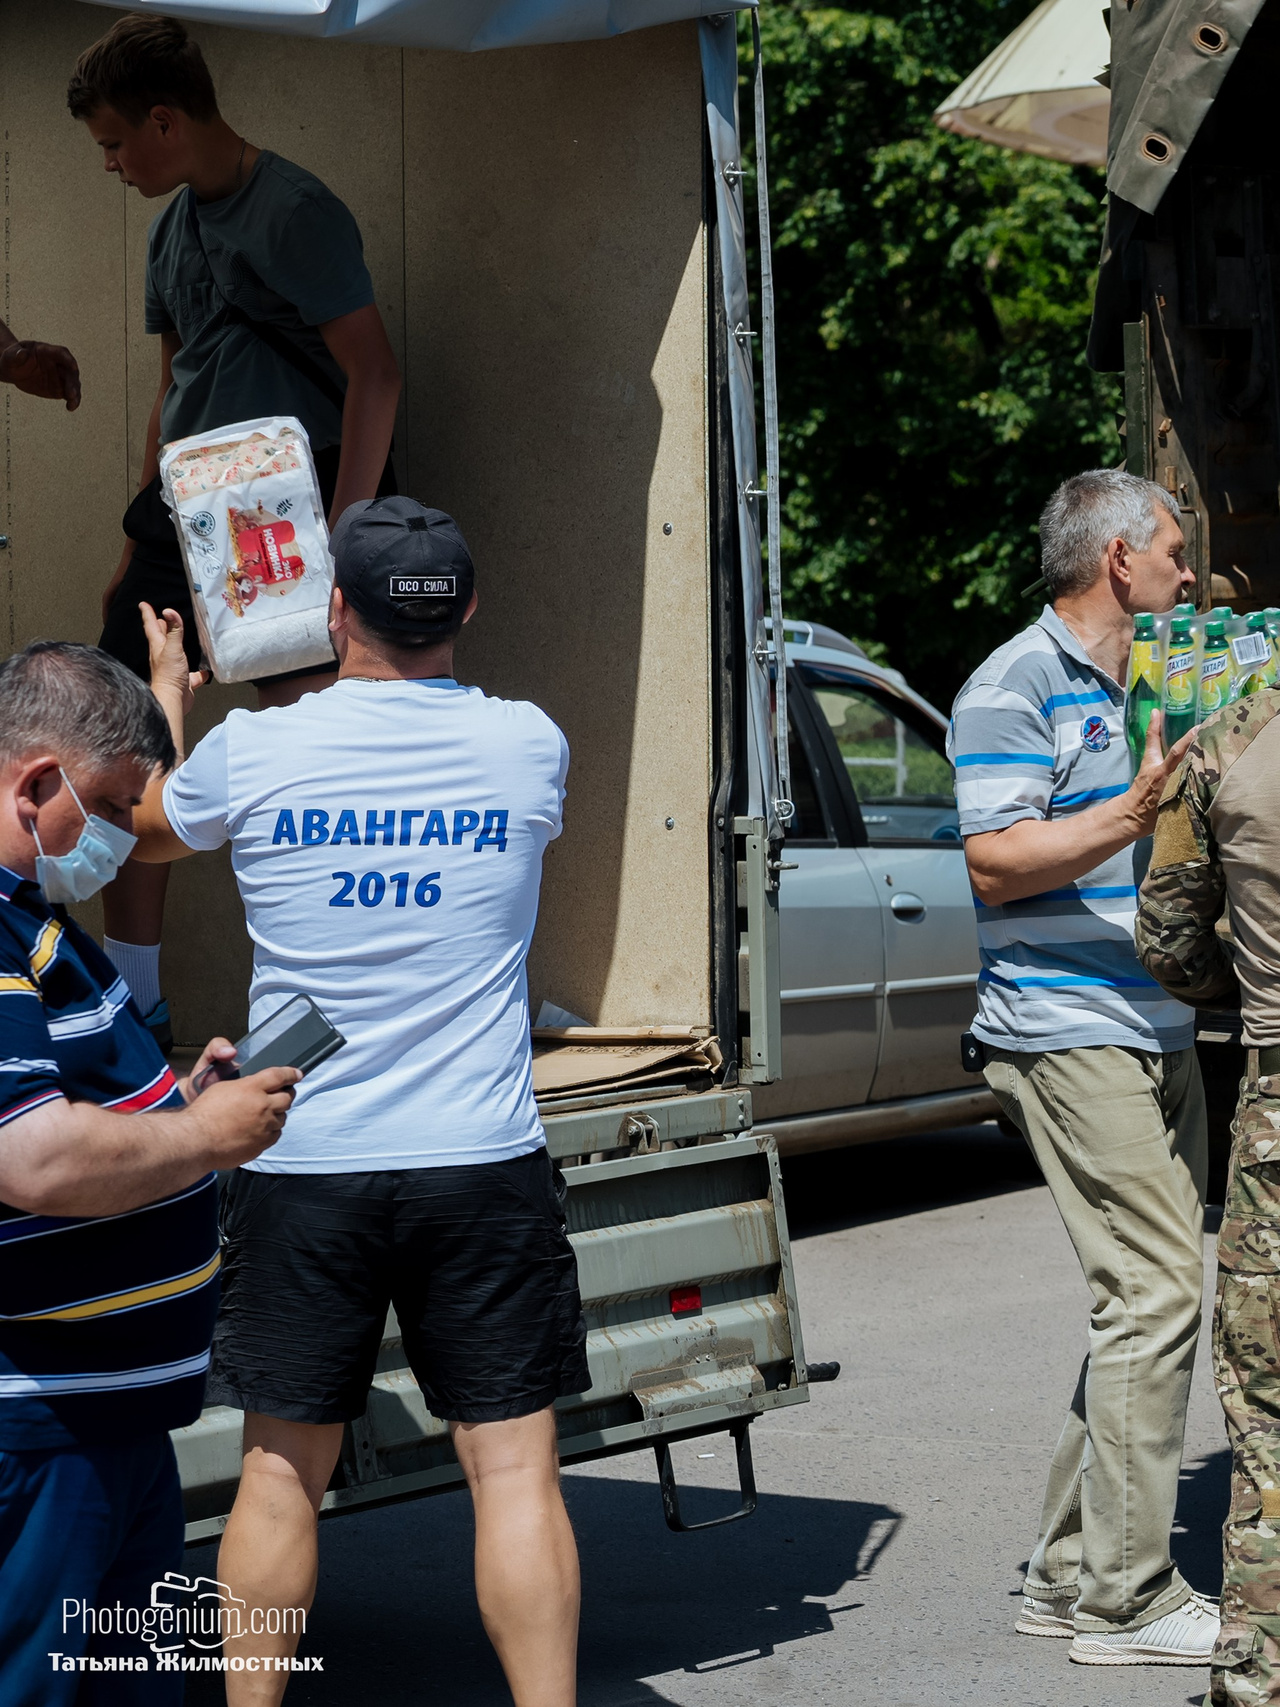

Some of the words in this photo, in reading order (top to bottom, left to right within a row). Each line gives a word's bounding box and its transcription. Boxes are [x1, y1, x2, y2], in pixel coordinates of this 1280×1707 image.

[206, 543, 215, 552] 12
[262, 527, 284, 581] НОВИНКА
[281, 559, 293, 579] ЭКО
[398, 580, 419, 592] ОСО
[423, 580, 449, 592] СИЛА
[271, 807, 509, 853] АВАНГАРД
[328, 870, 442, 908] 2016
